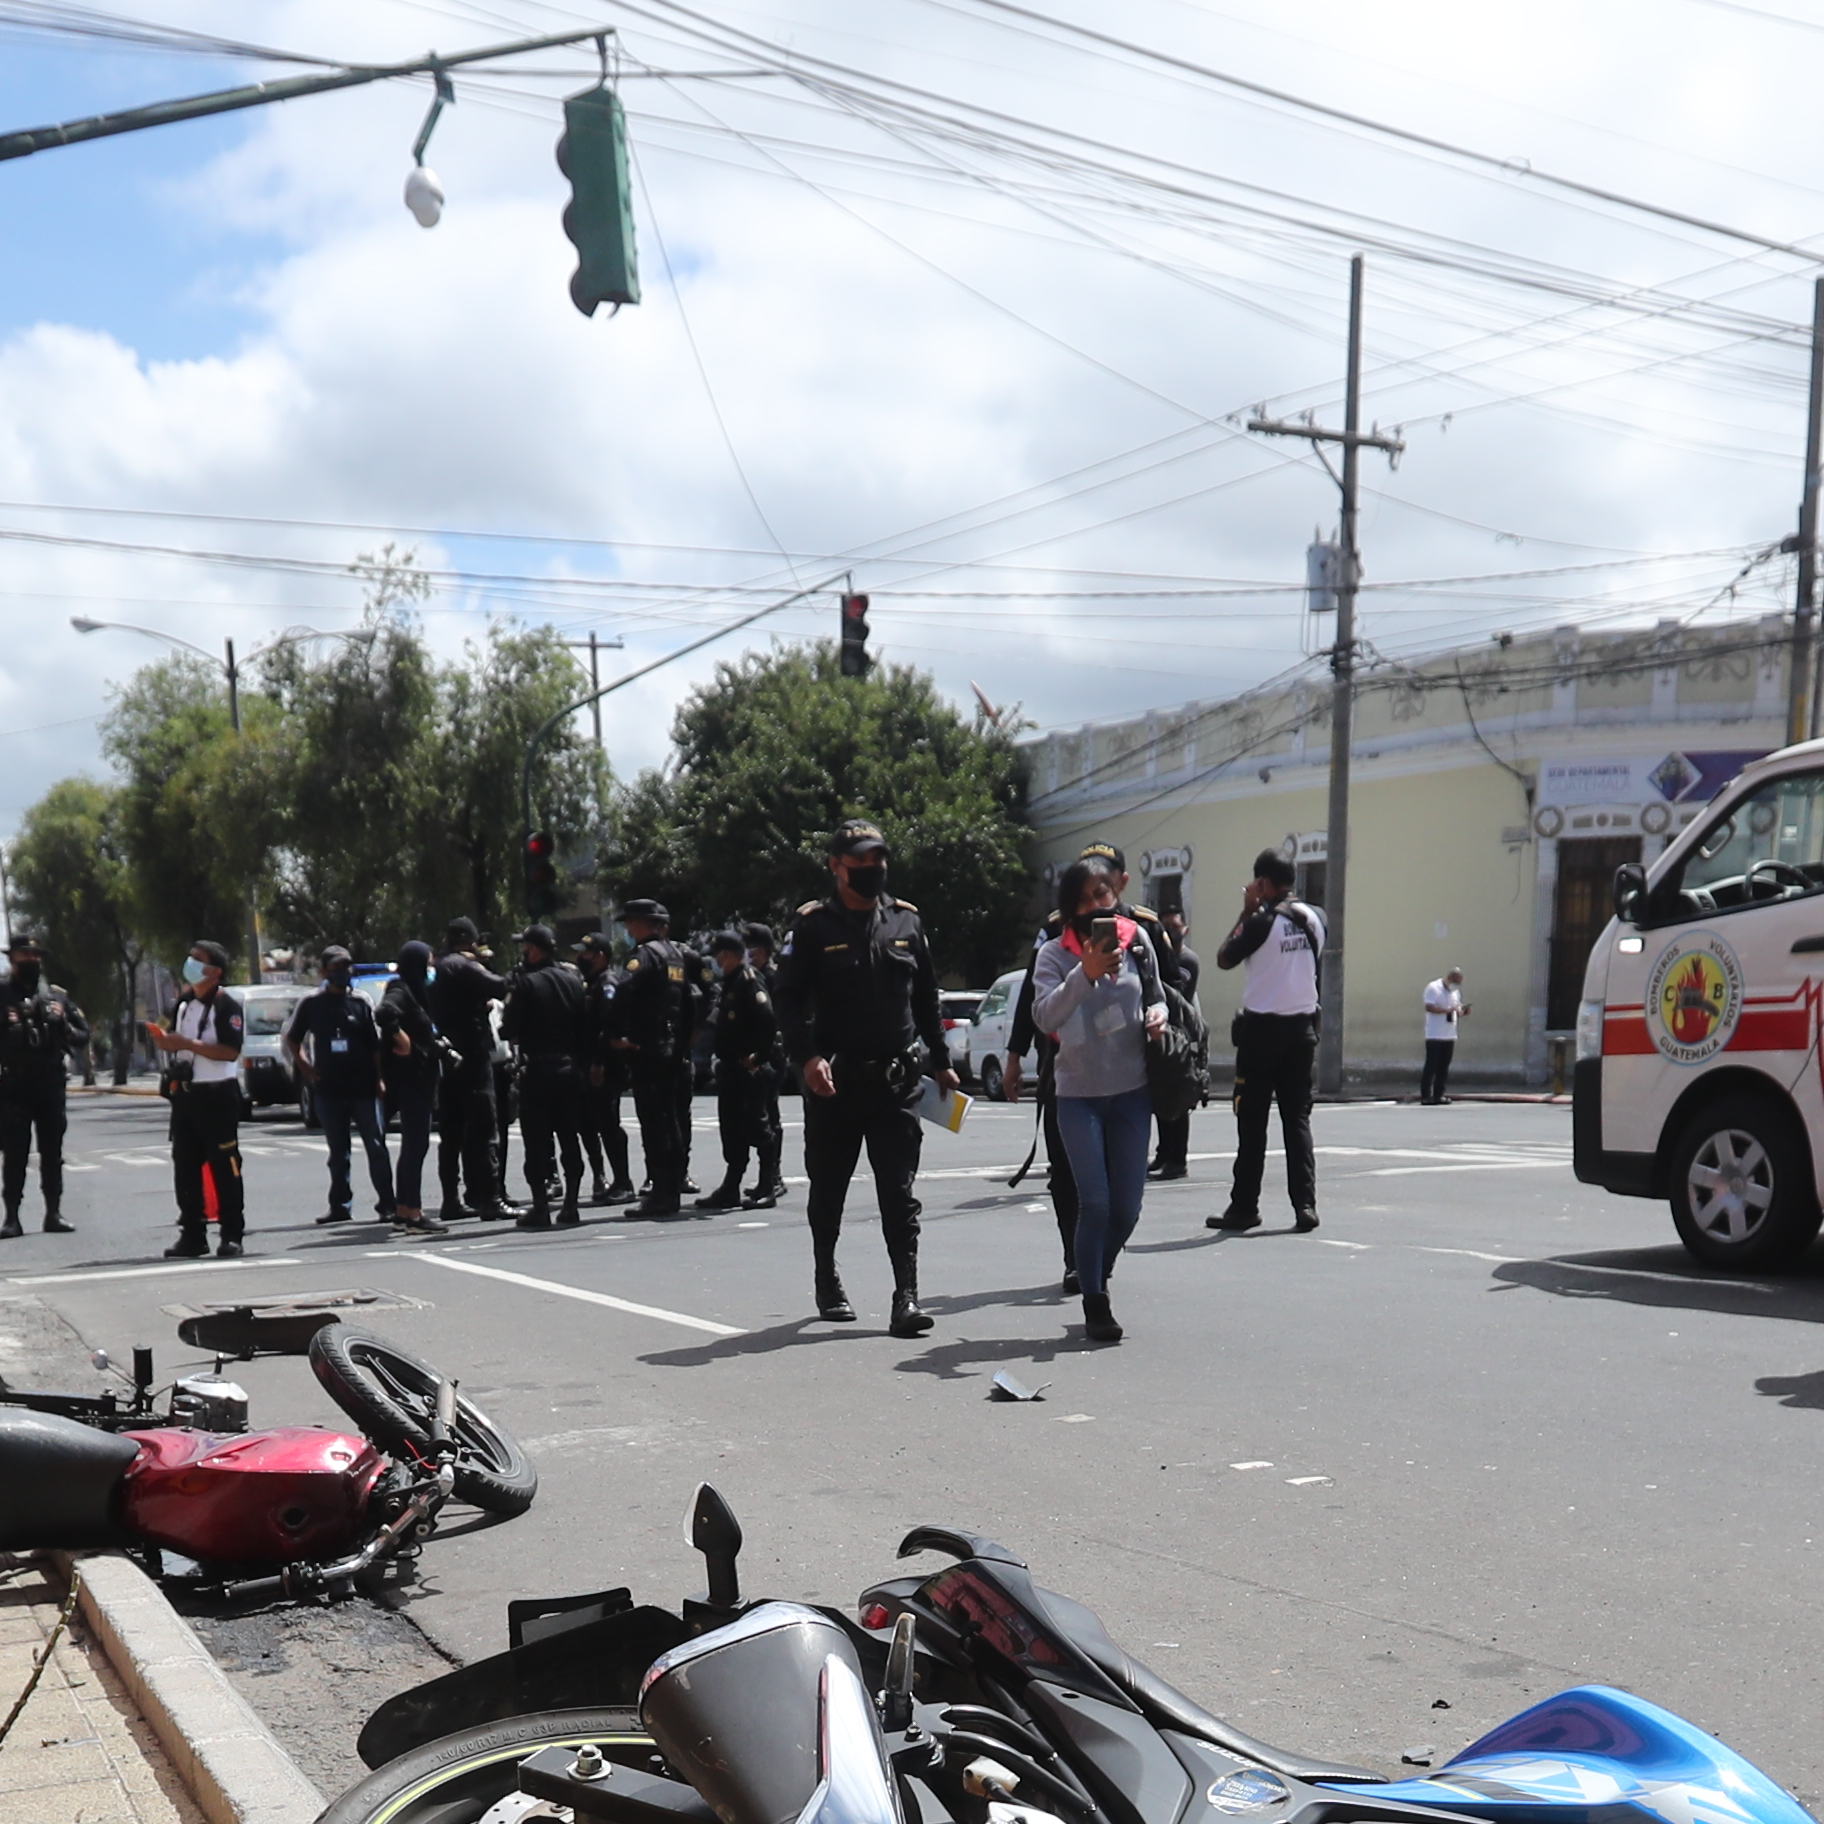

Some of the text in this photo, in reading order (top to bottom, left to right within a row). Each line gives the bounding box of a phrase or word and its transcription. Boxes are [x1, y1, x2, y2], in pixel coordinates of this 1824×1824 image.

[1569, 764, 1631, 777] DEPARTAMENTAL
[1547, 775, 1631, 792] GUATEMALA
[1650, 939, 1740, 1027] BOMBEROS VOLUNTARIOS
[1664, 985, 1676, 1002] C
[1713, 983, 1724, 1000] B
[1659, 1036, 1720, 1060] GUATEMALA
[436, 1739, 475, 1763] 140/60
[476, 1732, 499, 1748] R17
